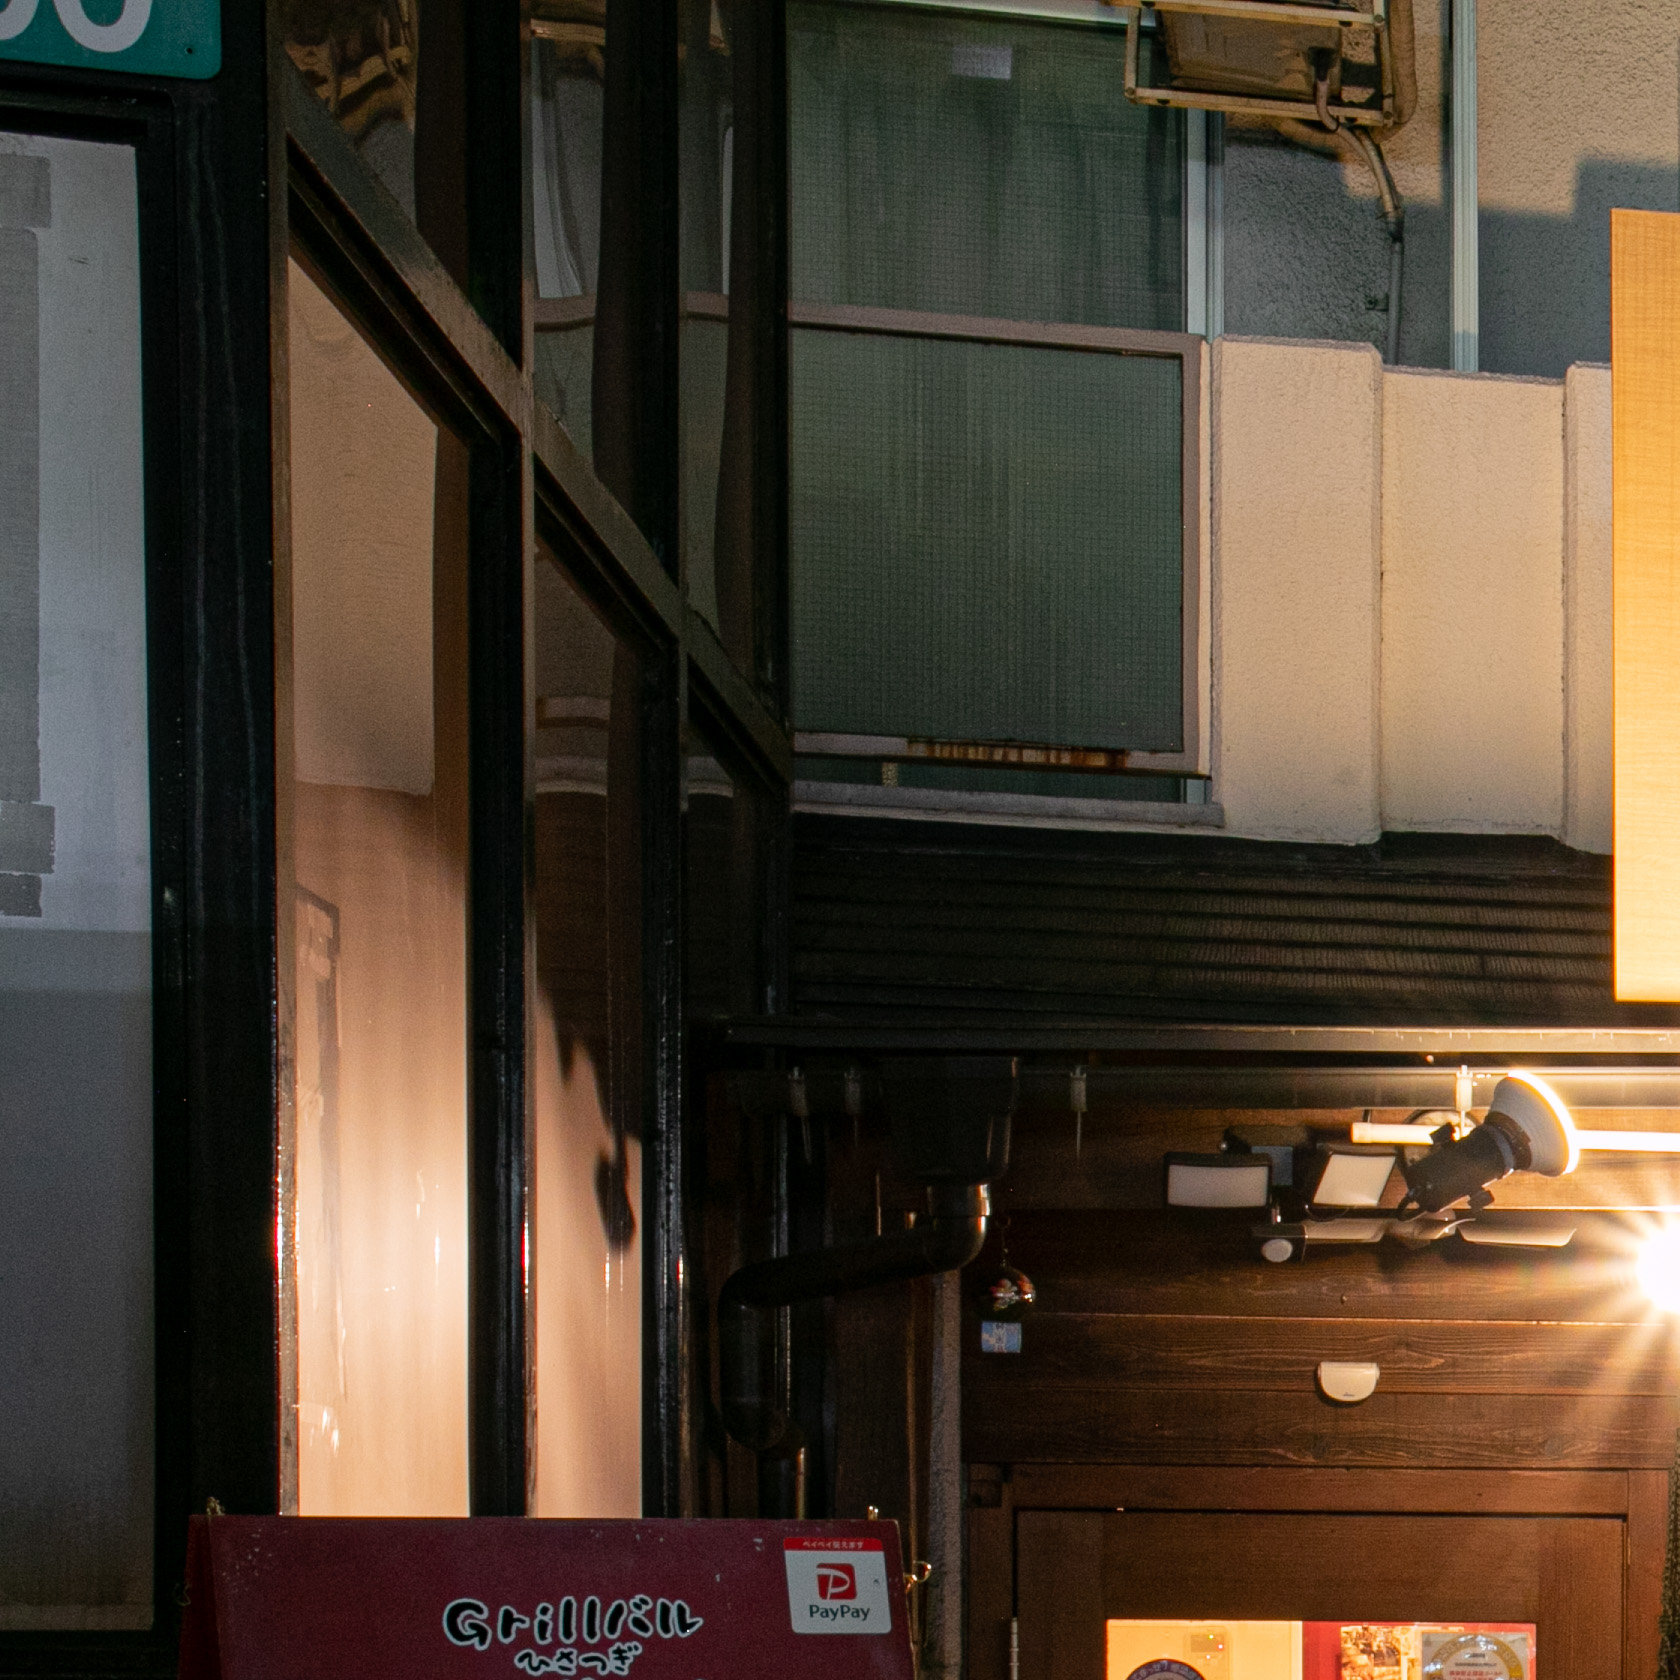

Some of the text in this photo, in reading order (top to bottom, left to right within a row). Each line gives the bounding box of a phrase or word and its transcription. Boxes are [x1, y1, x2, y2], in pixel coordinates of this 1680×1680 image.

[809, 1605, 870, 1621] PayPay
[515, 1643, 642, 1676] ひさつぎ
